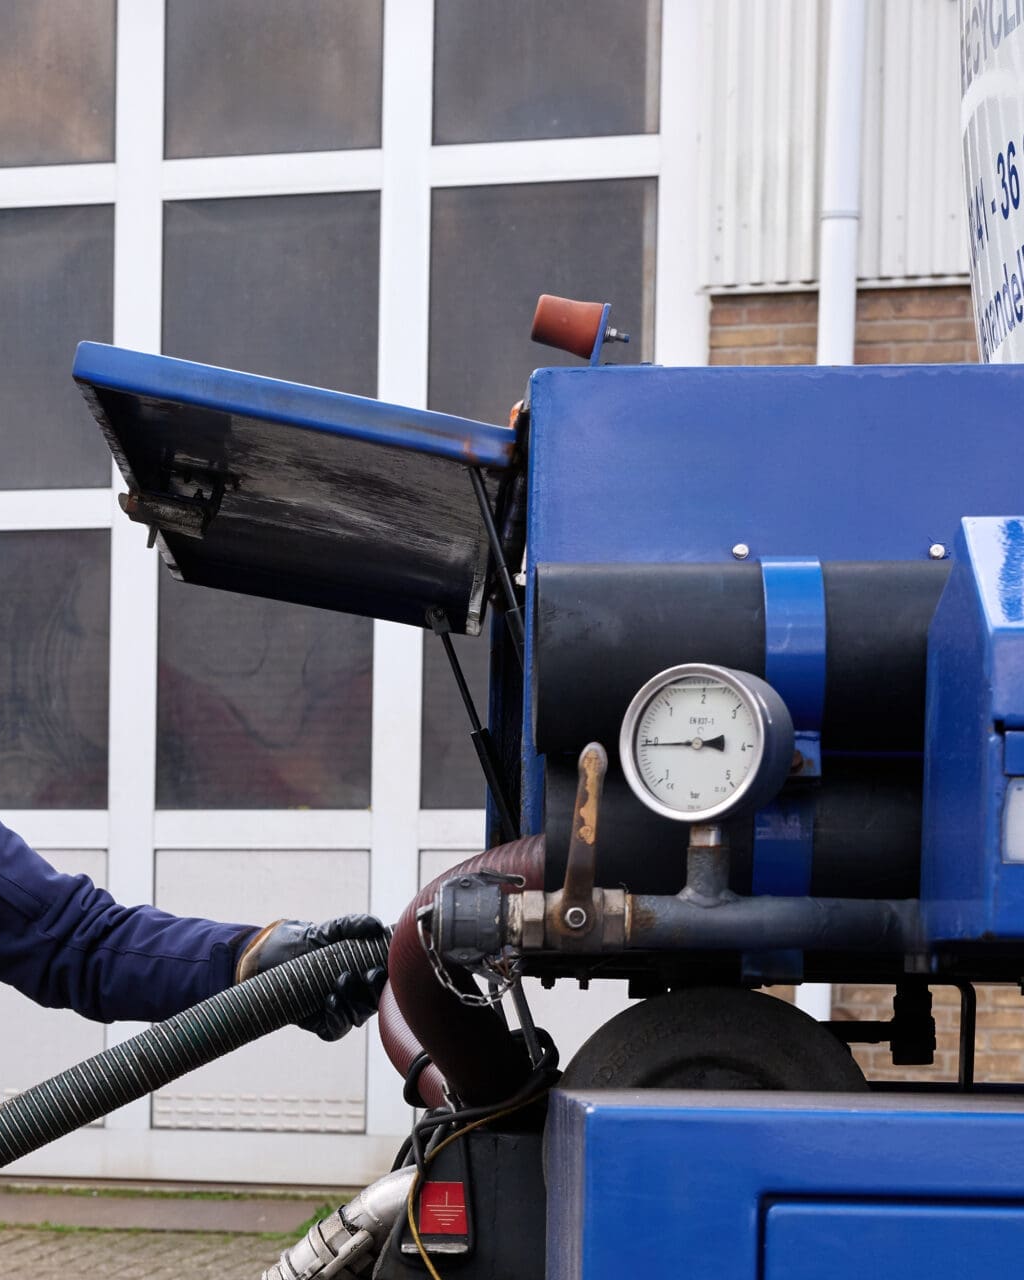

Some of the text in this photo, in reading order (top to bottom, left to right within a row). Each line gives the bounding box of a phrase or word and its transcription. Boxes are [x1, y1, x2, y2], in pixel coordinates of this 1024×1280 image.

[960, 0, 1024, 102] ECYCL
[997, 141, 1020, 220] 36
[700, 694, 706, 705] 2
[732, 709, 737, 720] 3
[741, 742, 747, 752] 4
[725, 769, 731, 780] 5
[690, 791, 700, 799] bar
